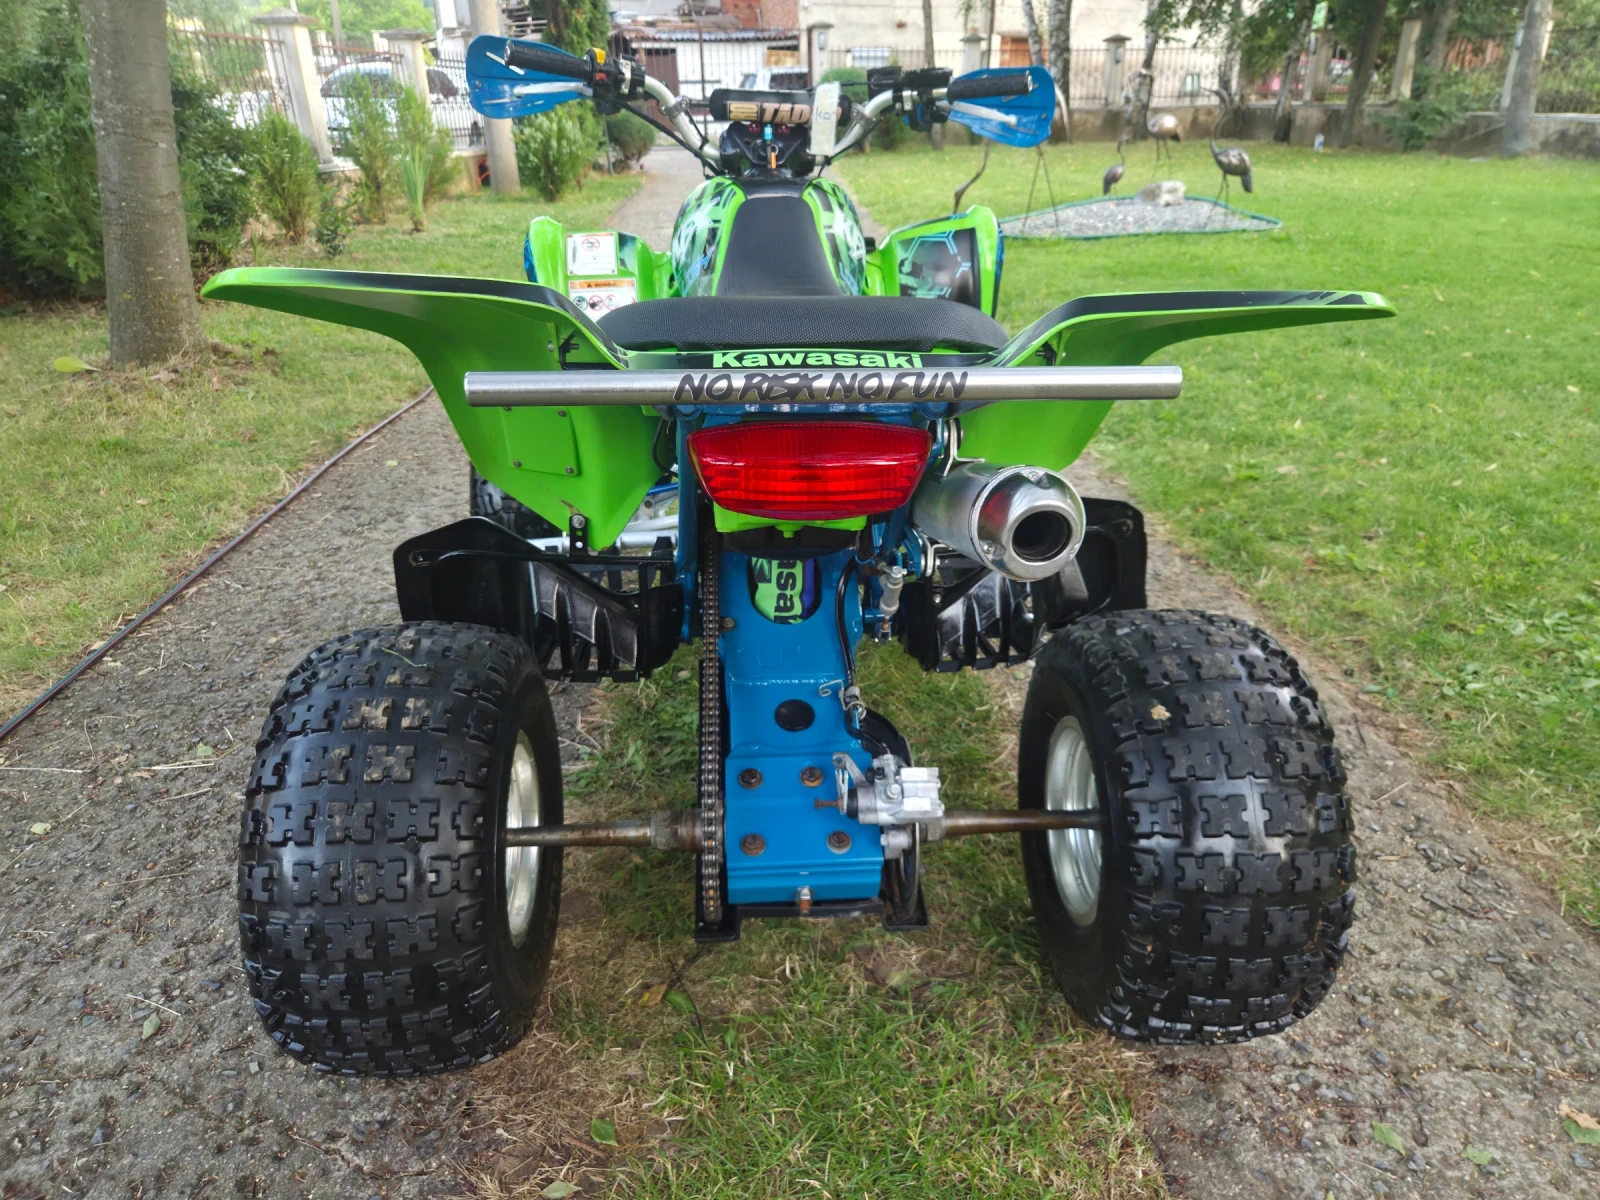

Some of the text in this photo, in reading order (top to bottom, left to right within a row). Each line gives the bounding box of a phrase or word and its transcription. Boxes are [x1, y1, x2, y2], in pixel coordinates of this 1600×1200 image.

[713, 351, 924, 368] Kawasaki
[673, 372, 968, 400] NO RISK NO FUN
